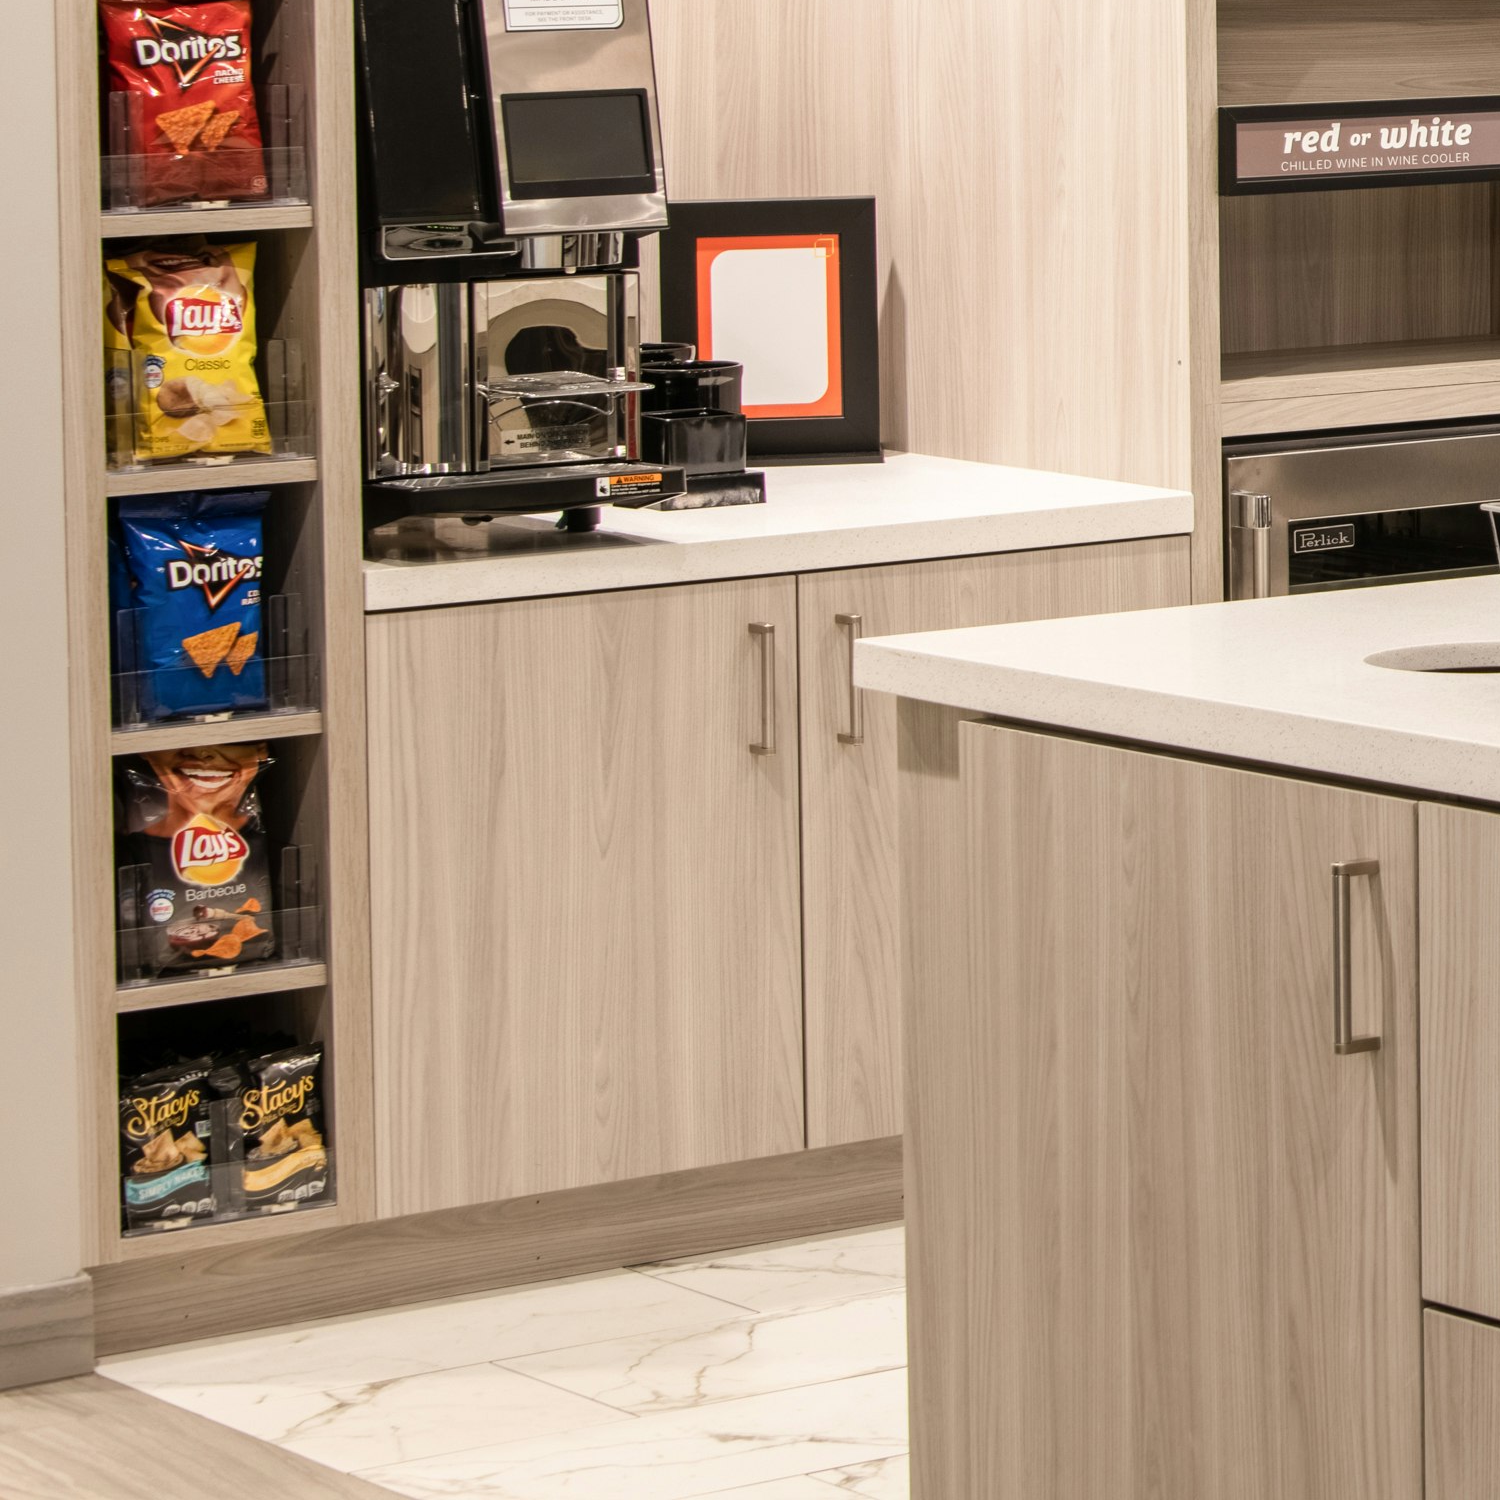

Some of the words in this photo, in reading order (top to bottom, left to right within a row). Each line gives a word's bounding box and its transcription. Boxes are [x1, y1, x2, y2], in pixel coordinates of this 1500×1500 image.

[136, 36, 241, 66] Doritos
[1283, 123, 1340, 154] red
[1350, 130, 1371, 146] or
[1380, 117, 1472, 149] white
[1281, 160, 1332, 171] CHILLED
[1336, 158, 1367, 169] WINE
[1371, 156, 1383, 168] IN
[1387, 155, 1418, 166] WINE
[1423, 152, 1470, 164] COOLER
[184, 358, 231, 371] Classic
[1299, 530, 1350, 549] Perlick
[180, 830, 241, 868] Lay's
[185, 883, 247, 901] Barbecue
[127, 1089, 200, 1136] Stacy's
[240, 1075, 314, 1129] Stacy's
